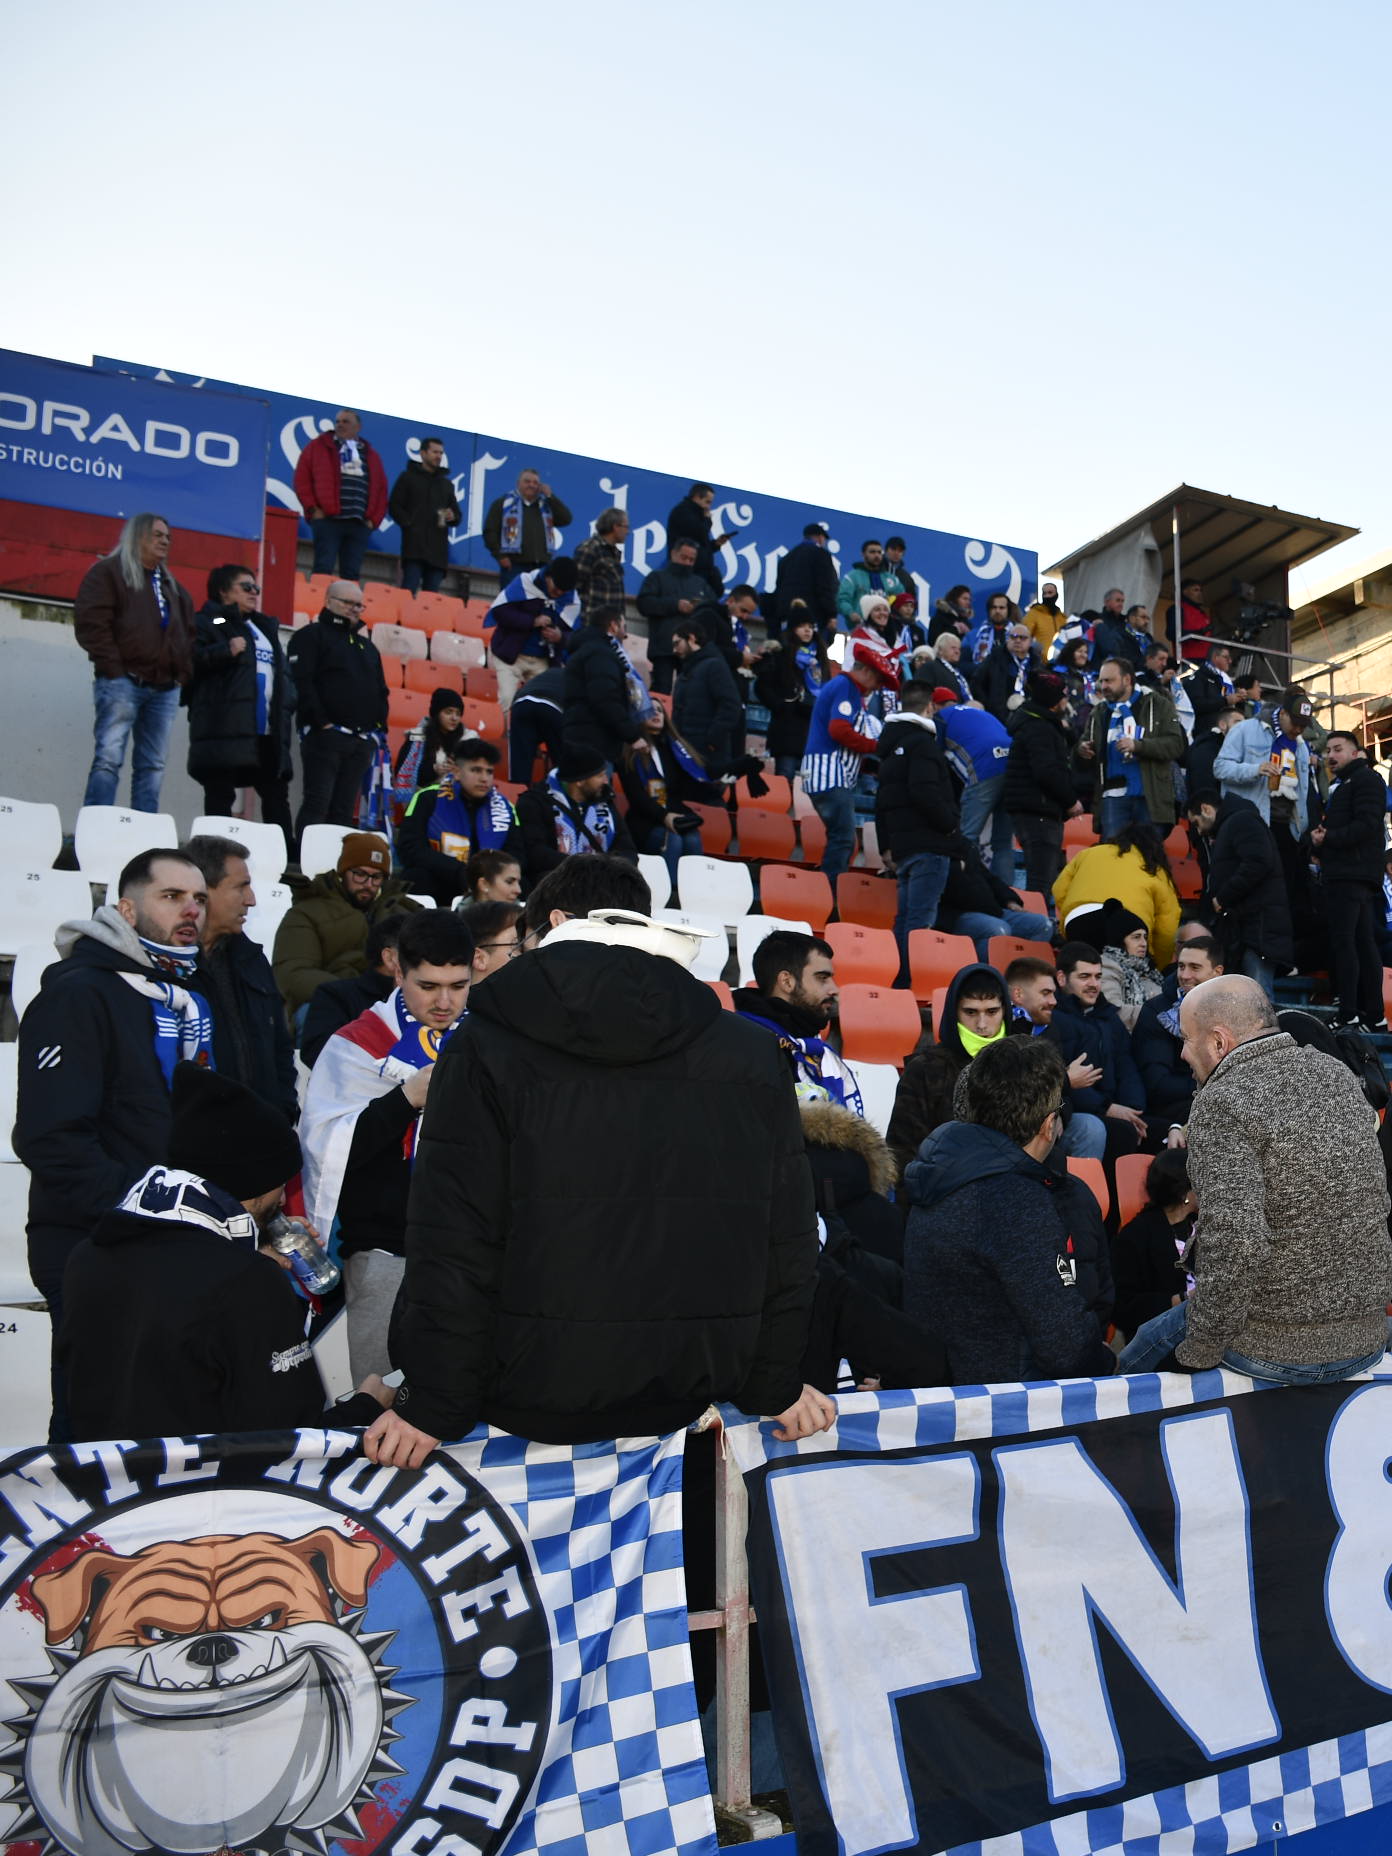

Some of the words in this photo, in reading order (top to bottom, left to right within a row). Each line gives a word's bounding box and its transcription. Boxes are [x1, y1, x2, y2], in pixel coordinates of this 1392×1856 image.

[0, 1323, 17, 1334] 24
[0, 1435, 221, 1580] NTE
[265, 1427, 531, 1644] NORTE
[766, 1408, 1282, 1856] FN
